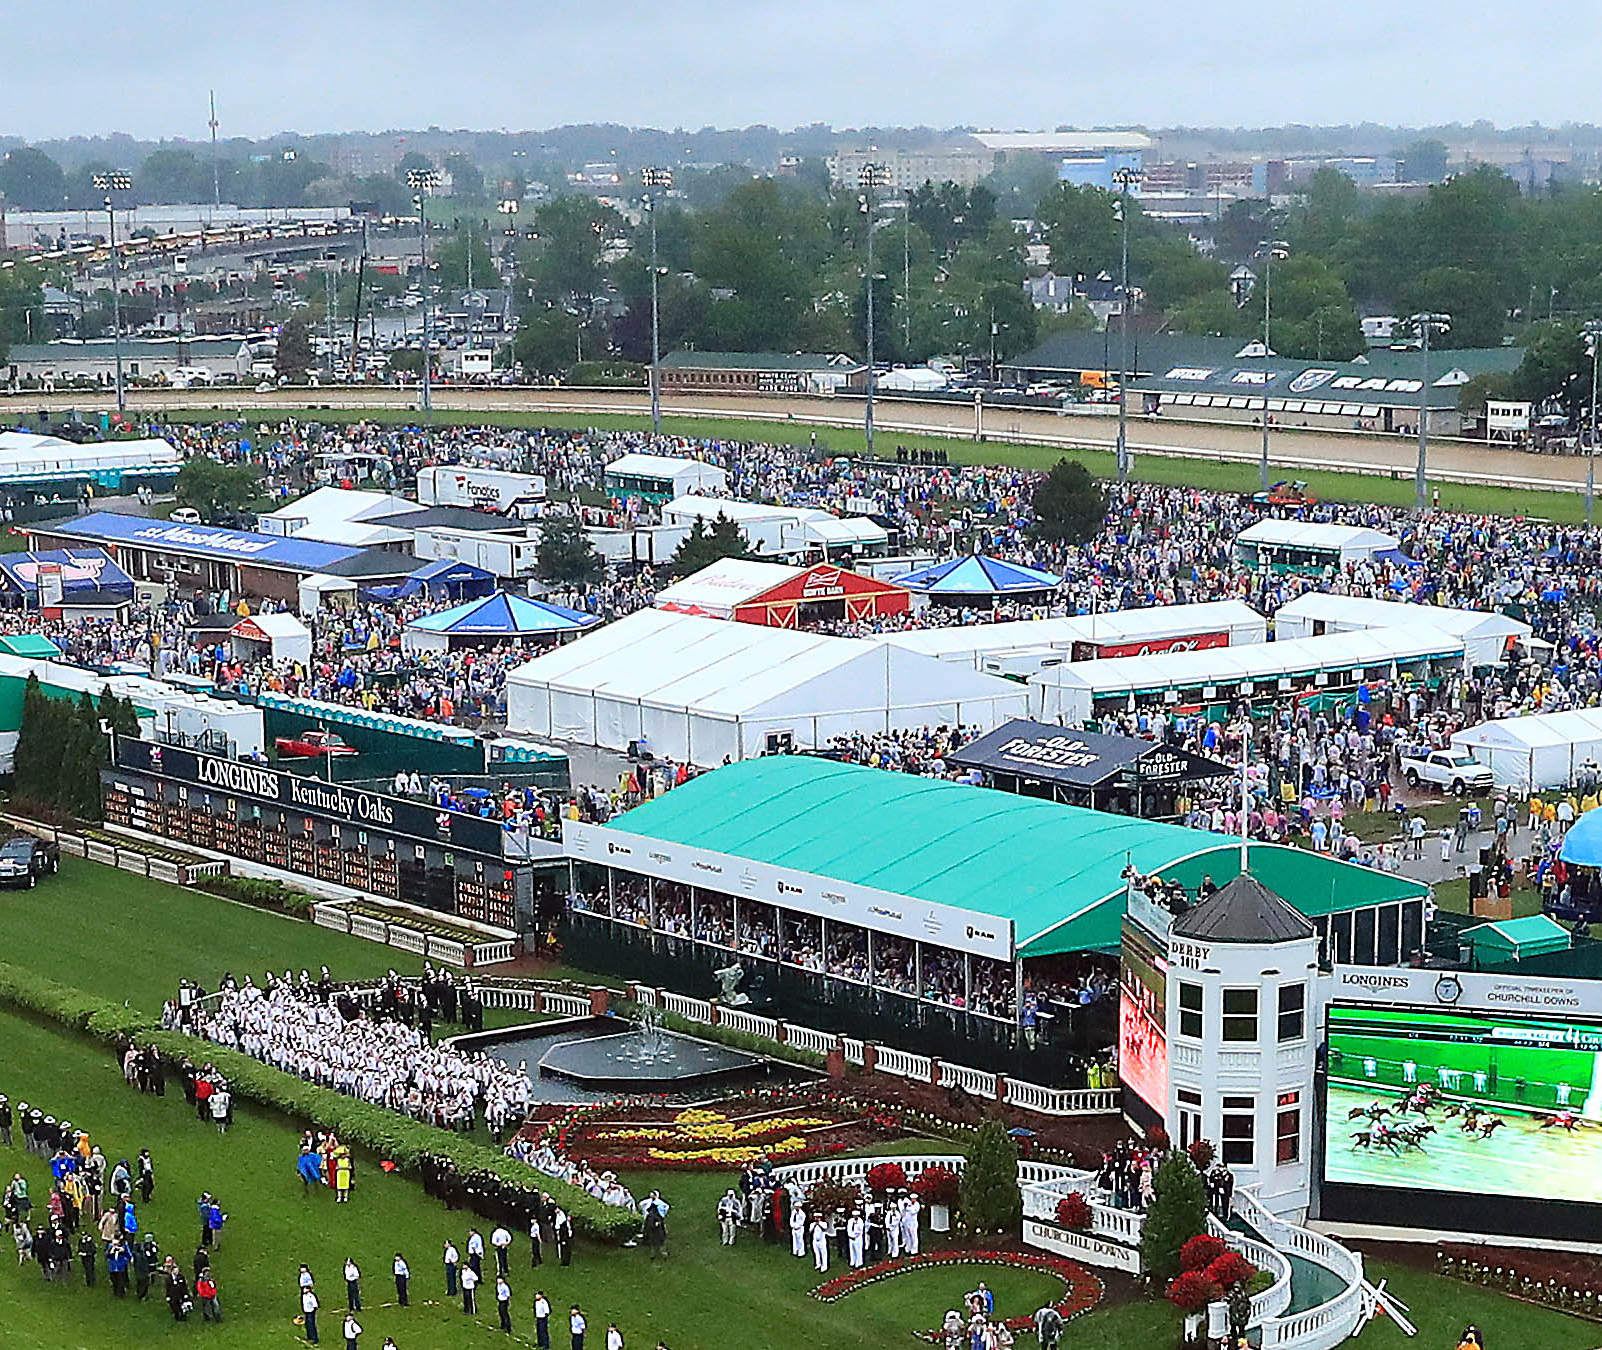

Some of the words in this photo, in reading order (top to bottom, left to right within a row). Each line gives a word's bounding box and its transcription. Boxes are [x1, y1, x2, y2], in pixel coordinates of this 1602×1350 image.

[467, 481, 500, 499] Fanatics
[159, 527, 278, 552] MassMutual
[999, 738, 1100, 767] FORESTER
[1140, 760, 1188, 774] FORESTER
[197, 757, 279, 798] LONGINES
[291, 777, 355, 820] Kentucky
[357, 794, 394, 824] Oaks
[1171, 941, 1210, 960] DERBY
[1342, 974, 1409, 989] LONGINES
[1487, 993, 1539, 1004] CHURCHILL
[1544, 996, 1580, 1006] DOWNS
[1032, 1225, 1090, 1250] CHURCHILL
[1094, 1241, 1130, 1260] DOWNS
